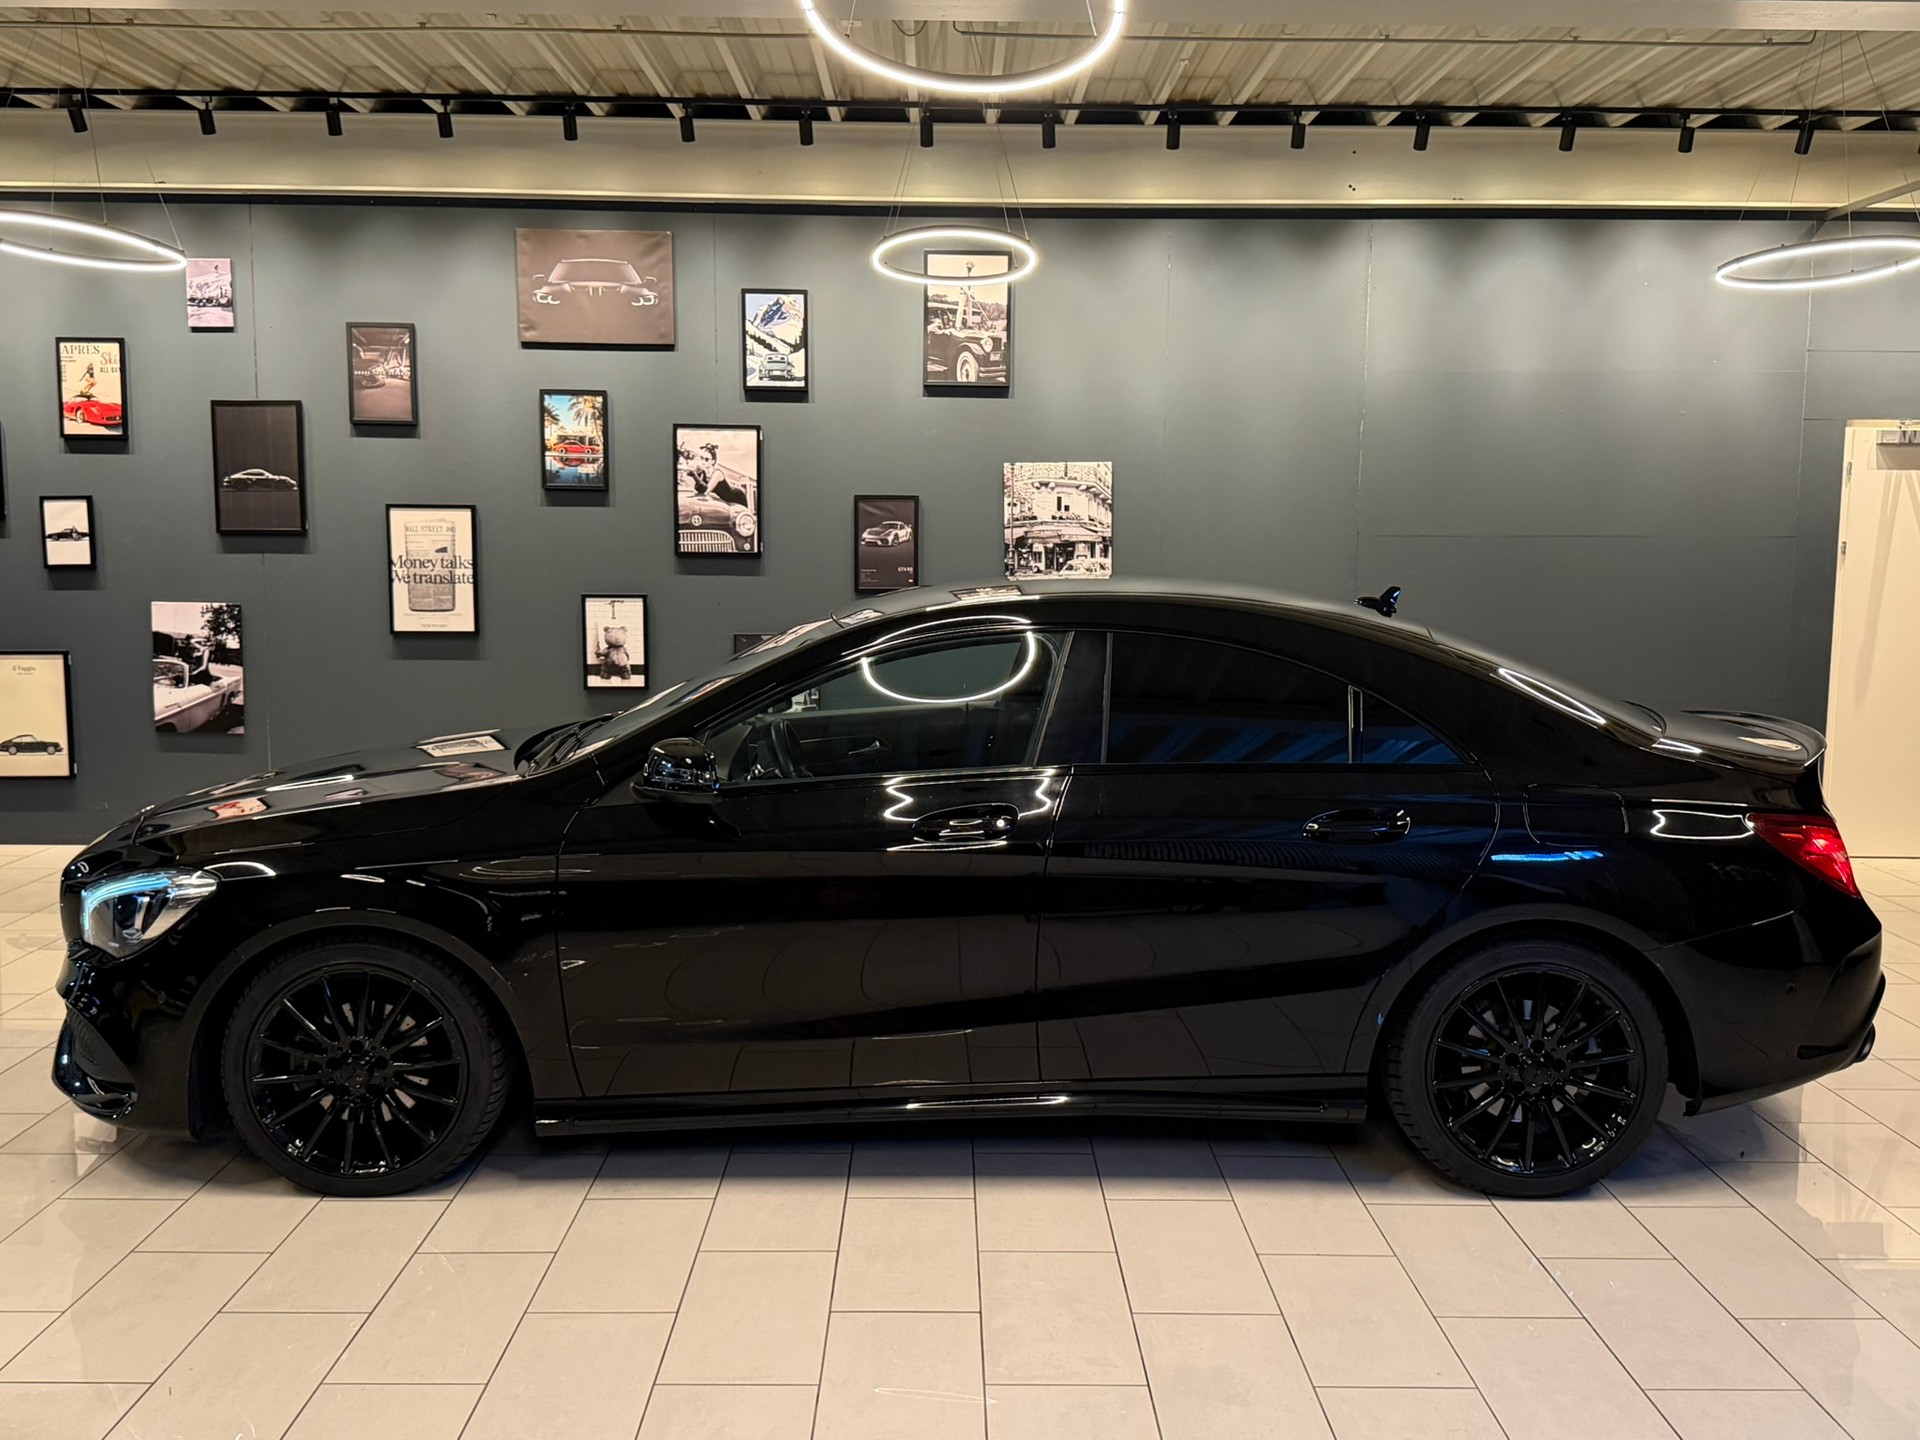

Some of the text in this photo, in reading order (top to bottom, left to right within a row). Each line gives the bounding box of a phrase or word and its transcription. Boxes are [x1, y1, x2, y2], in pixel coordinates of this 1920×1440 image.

[100, 352, 118, 365] Ski
[420, 525, 443, 533] STREET
[391, 554, 473, 571] Money talks
[413, 570, 474, 585] translate
